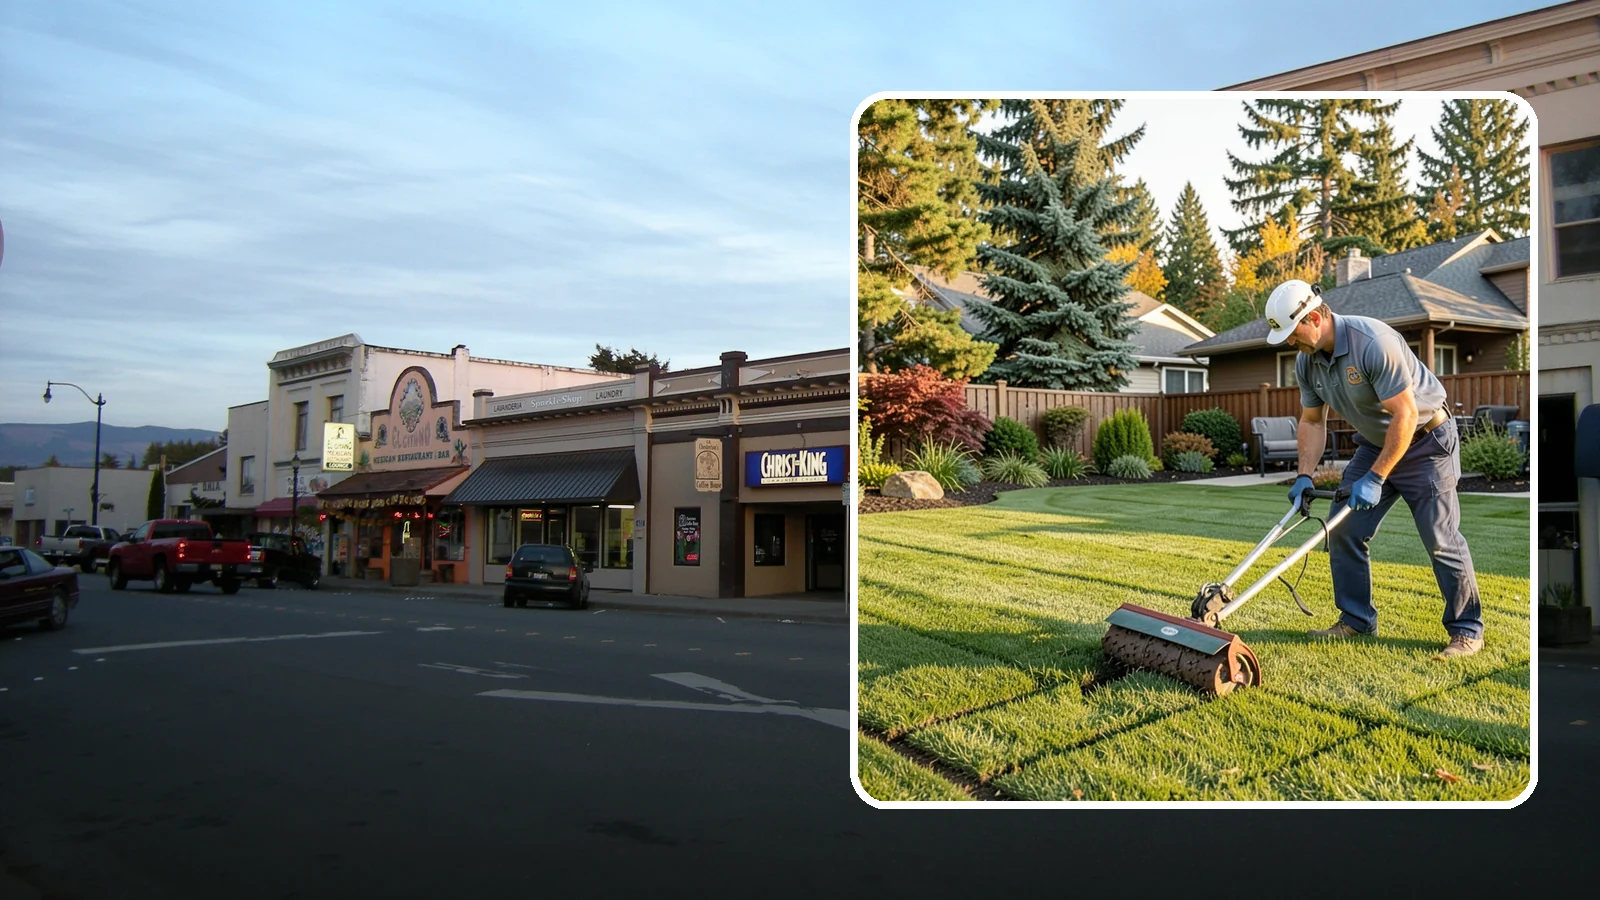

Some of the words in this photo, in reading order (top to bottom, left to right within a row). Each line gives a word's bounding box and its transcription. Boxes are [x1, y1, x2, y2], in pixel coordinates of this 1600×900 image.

[493, 402, 522, 412] LAVANDERIA
[561, 394, 583, 404] Shop
[595, 389, 624, 400] LAUNDRY
[373, 455, 396, 464] MEXICAN
[397, 451, 434, 462] RESTAURANT
[438, 450, 450, 459] BAR
